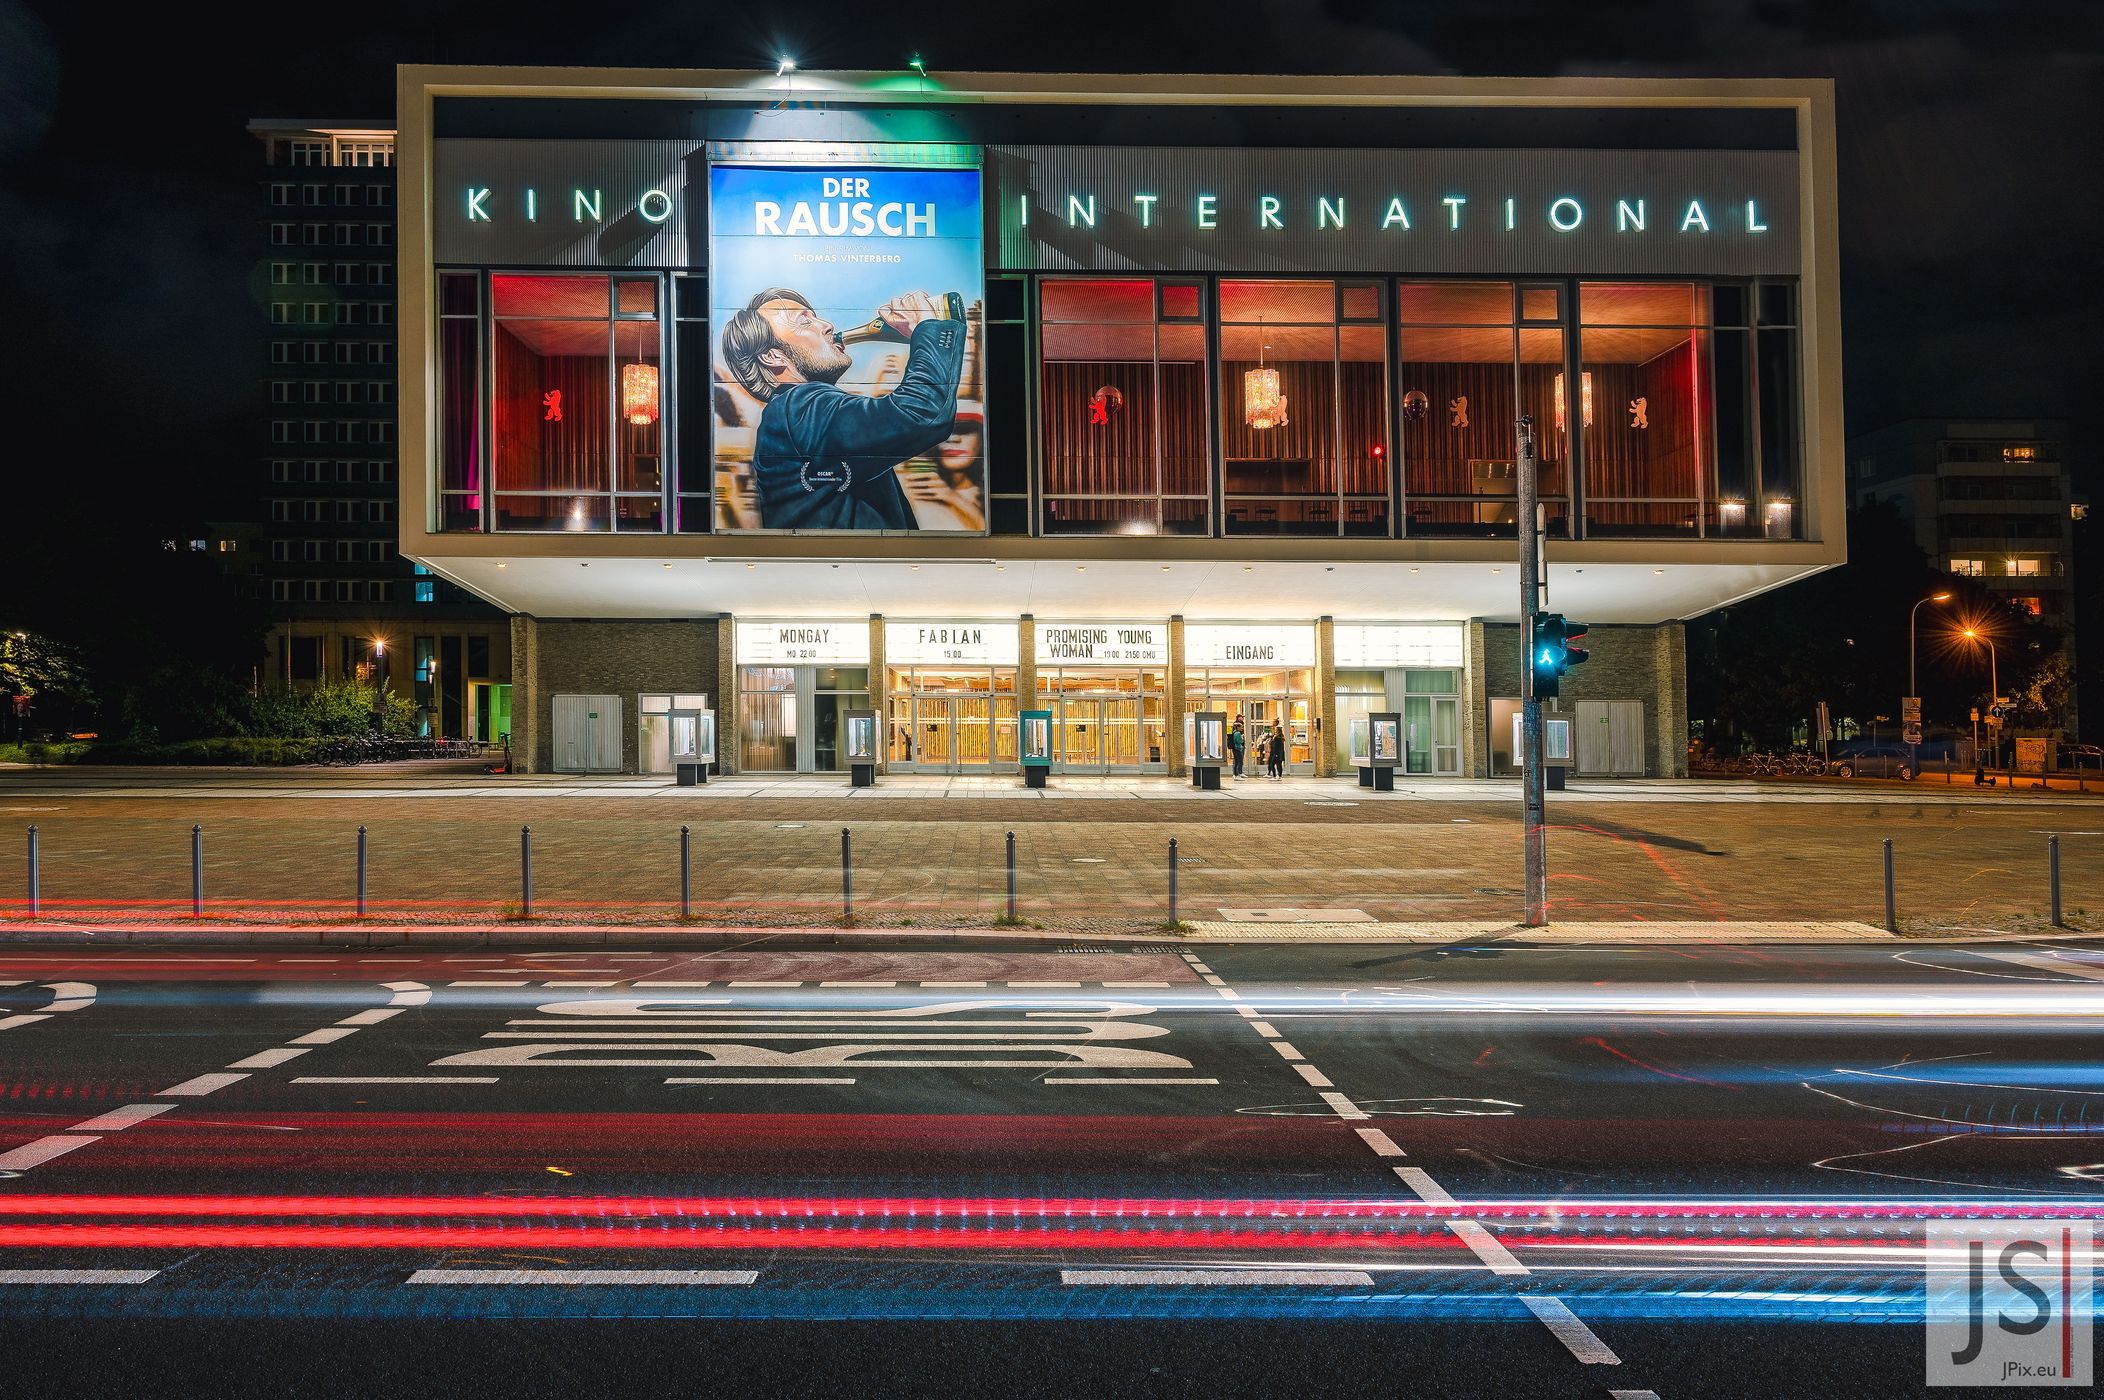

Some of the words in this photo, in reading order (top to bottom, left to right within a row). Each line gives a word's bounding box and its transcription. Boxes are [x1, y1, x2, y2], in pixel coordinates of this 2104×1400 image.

[823, 177, 870, 198] DER
[468, 188, 673, 223] KINO
[1020, 194, 1768, 232] INTERNATIONAL
[755, 201, 936, 237] RAUSCH
[793, 254, 837, 263] THOMAS
[840, 254, 901, 264] VINTERBERG
[779, 629, 830, 643] MONGAY
[919, 629, 981, 644] FABIAN
[1046, 629, 1108, 643] PROMISING
[1117, 630, 1152, 644] YOUNG
[1050, 644, 1093, 658] WOMAN
[1226, 645, 1275, 660] EINGANG
